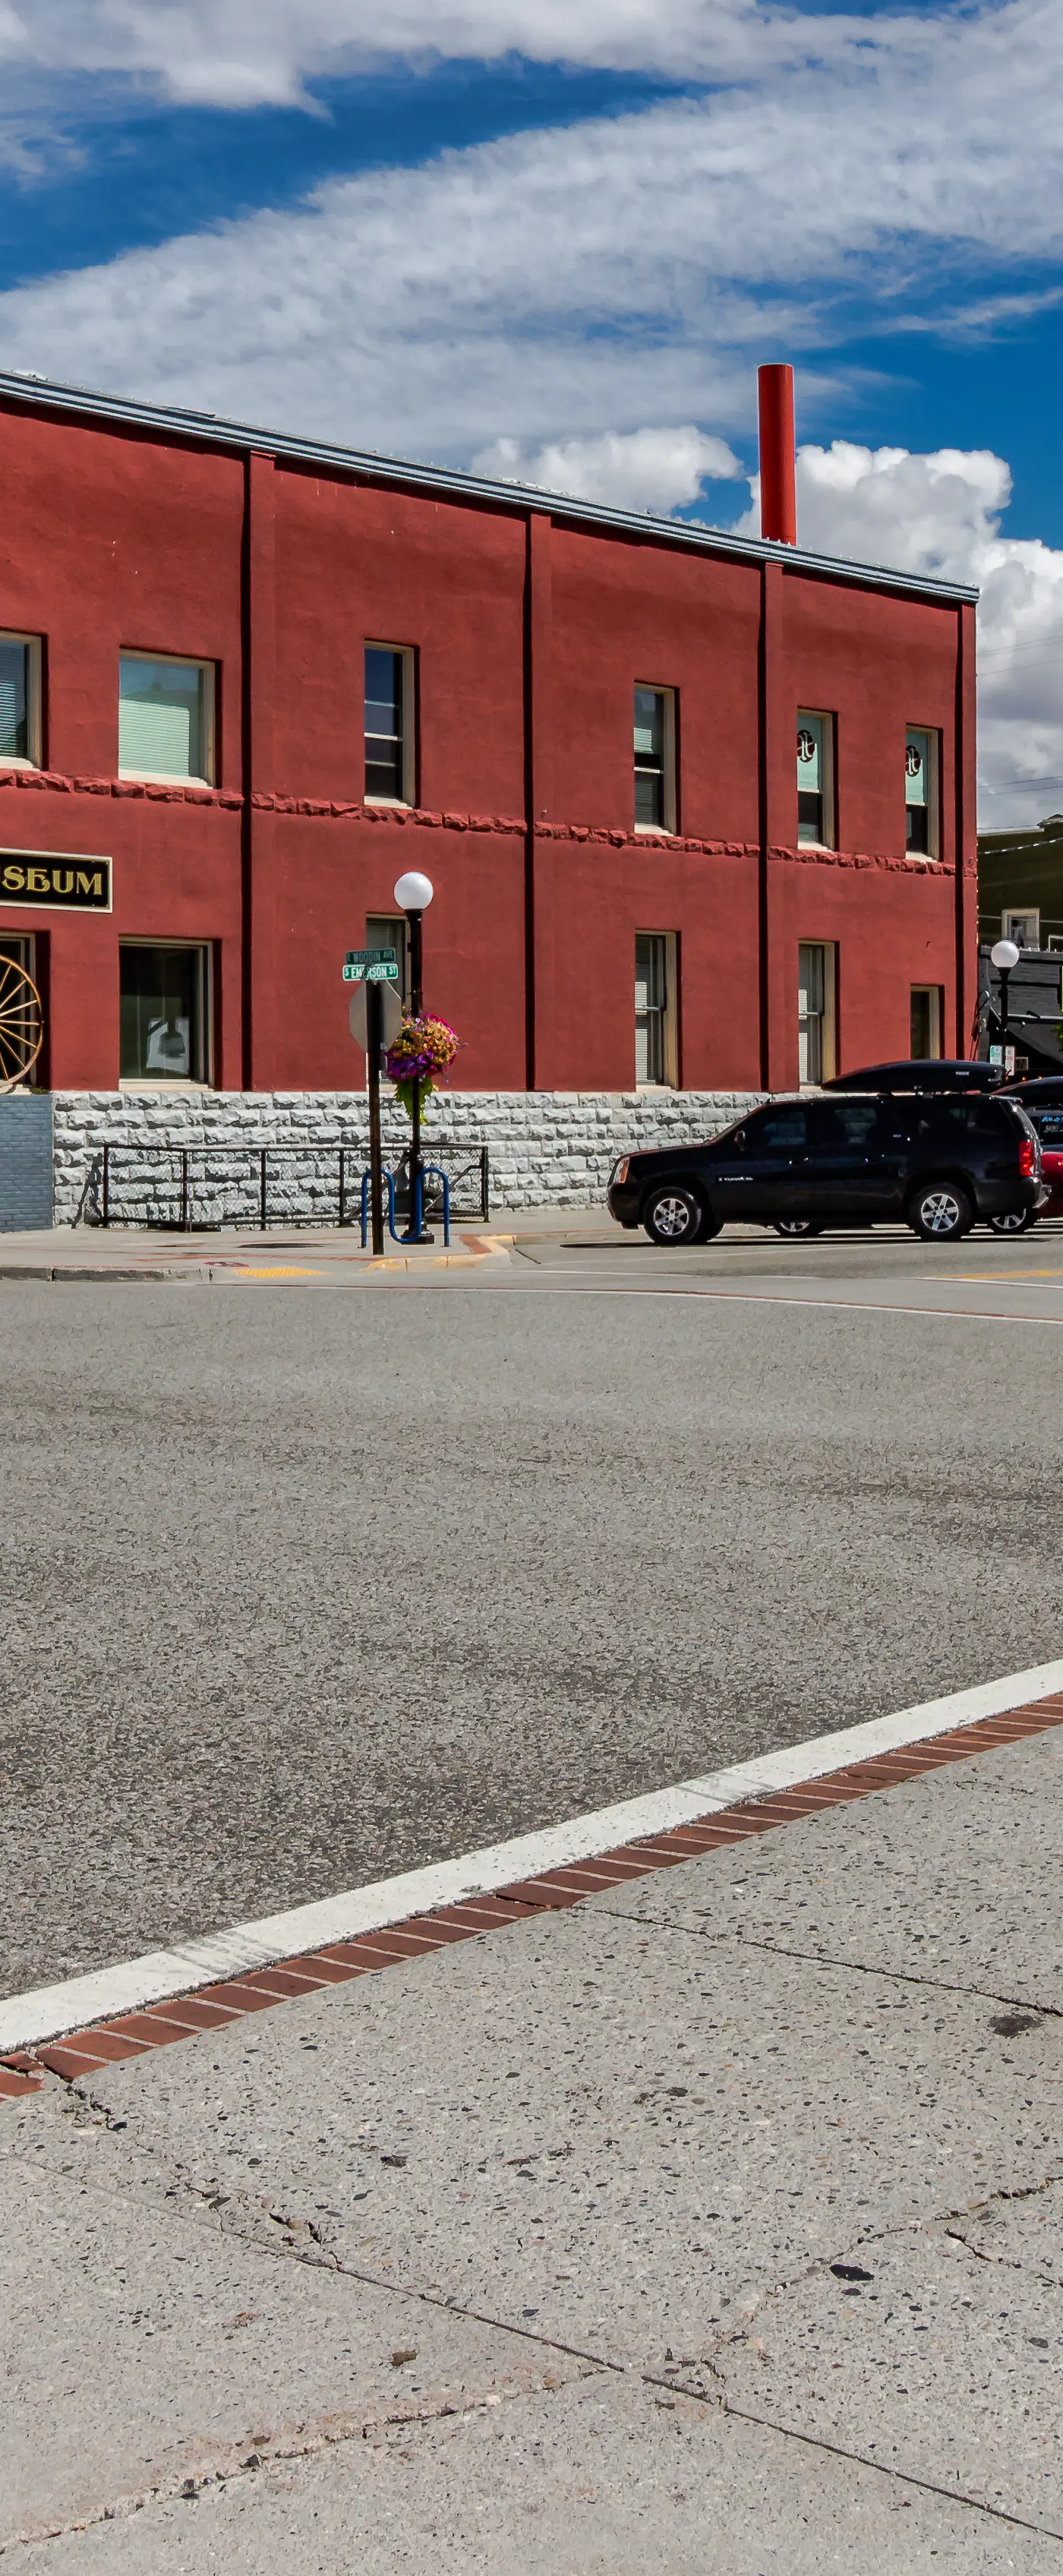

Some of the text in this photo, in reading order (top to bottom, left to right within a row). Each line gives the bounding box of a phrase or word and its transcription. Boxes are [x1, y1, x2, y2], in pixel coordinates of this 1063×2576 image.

[0, 866, 103, 895] SEUM
[353, 952, 380, 962] WOODIN
[383, 950, 393, 958] AVE
[345, 968, 349, 977] S
[389, 965, 396, 974] ST
